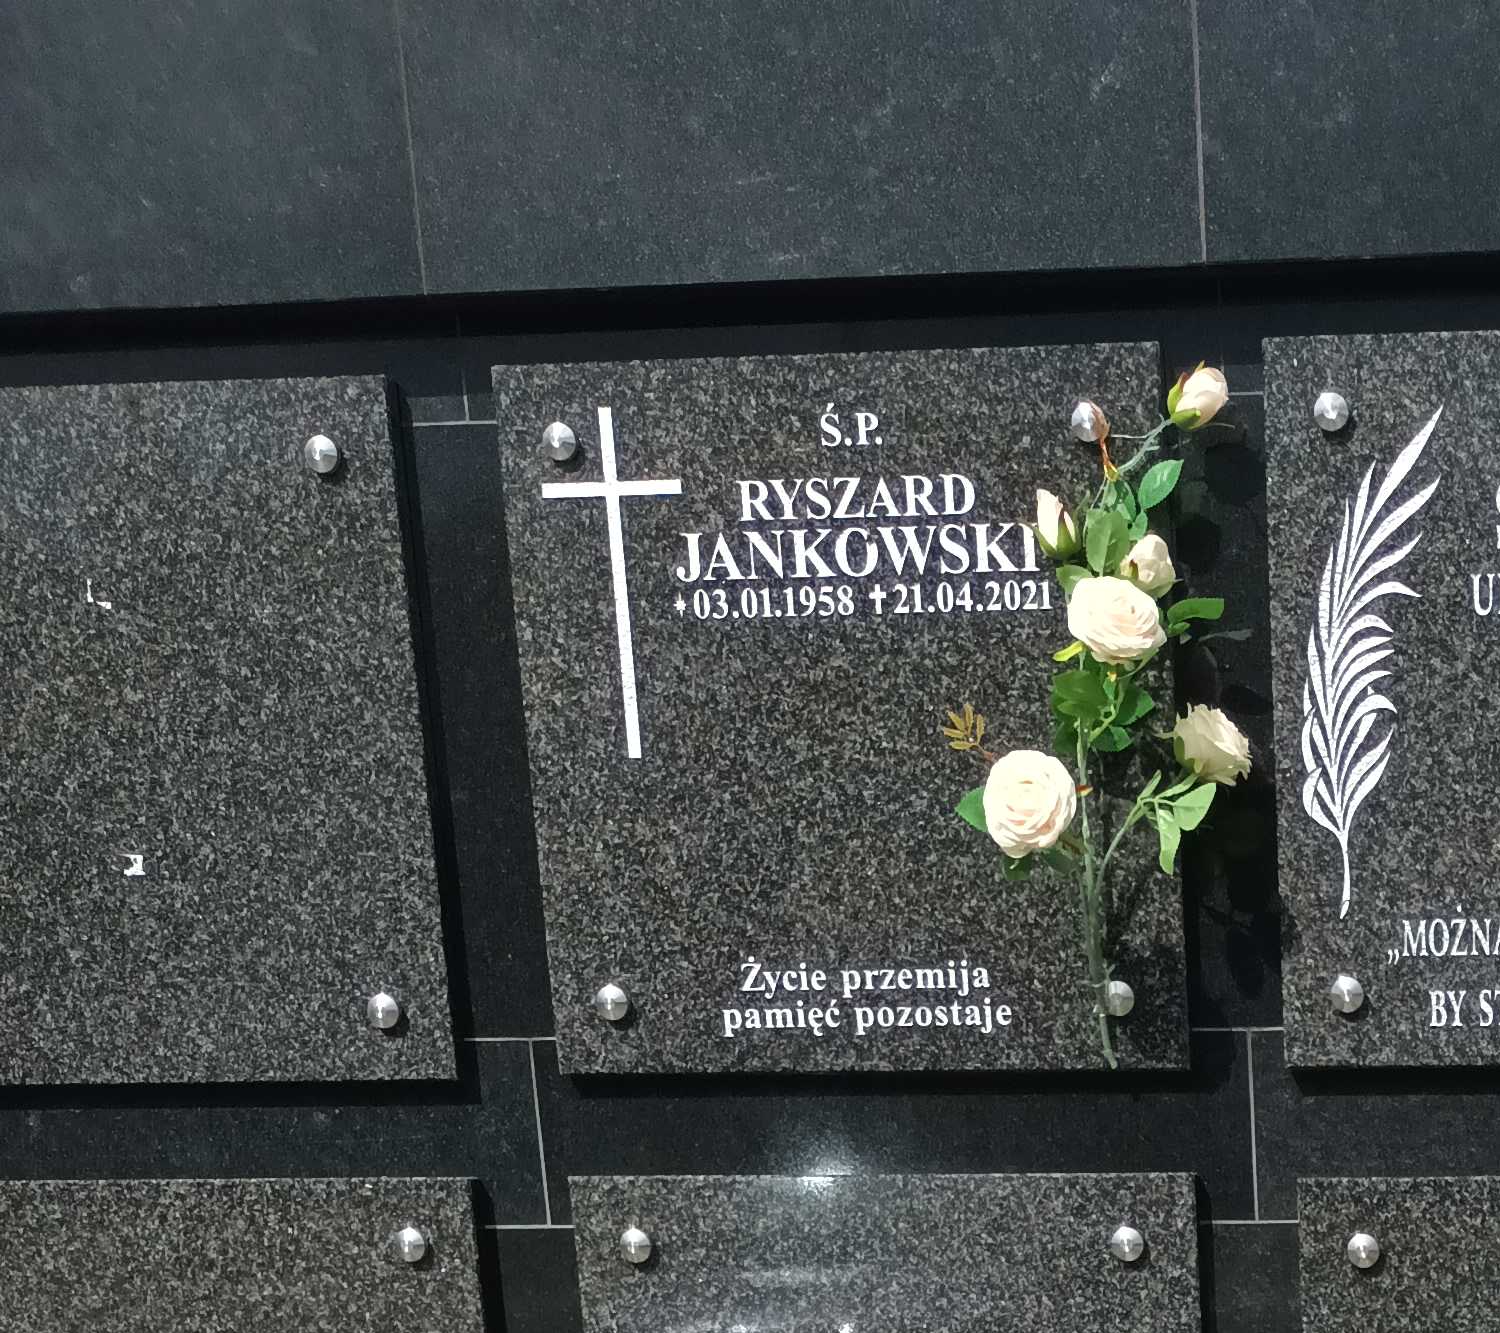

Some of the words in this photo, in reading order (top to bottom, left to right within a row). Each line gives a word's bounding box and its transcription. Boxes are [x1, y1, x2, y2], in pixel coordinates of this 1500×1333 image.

[820, 402, 883, 448] Ś.P.
[735, 473, 977, 522] RYSZARD
[675, 521, 1041, 583] JANKOWSKI
[740, 956, 827, 998] Życie
[840, 959, 991, 997] przemija
[721, 998, 841, 1038] pamięć
[853, 997, 1012, 1036] pozostaje
[1428, 988, 1467, 1027] BY
